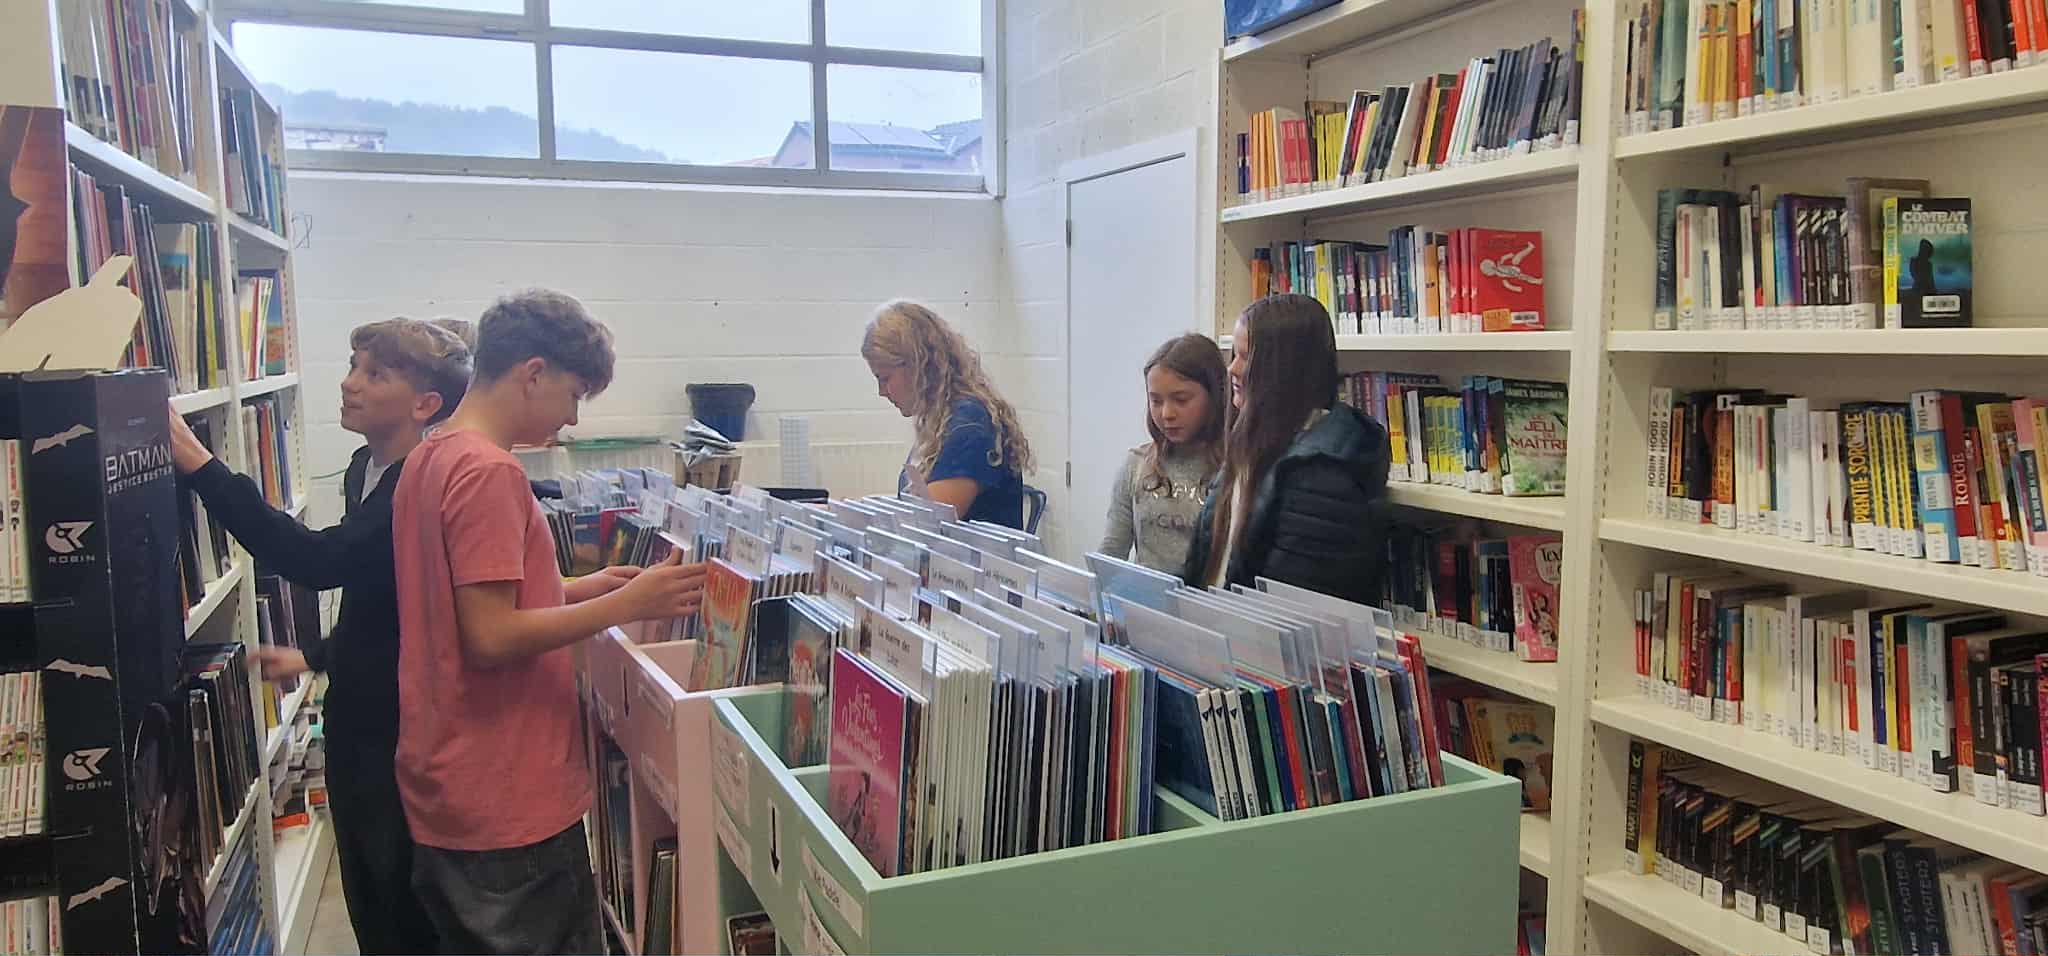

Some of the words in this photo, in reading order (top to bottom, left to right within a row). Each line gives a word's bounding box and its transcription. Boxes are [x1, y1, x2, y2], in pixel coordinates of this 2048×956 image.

[1911, 203, 1923, 211] LE
[1902, 210, 1969, 223] COMBAT
[1902, 222, 1969, 235] D'HIVER
[1524, 420, 1556, 433] JEU
[1649, 420, 1658, 453] HOOD
[105, 443, 172, 482] BATMAN
[1952, 452, 1969, 506] ROUGE
[48, 554, 96, 565] ROBIN
[65, 780, 113, 791] ROBIN
